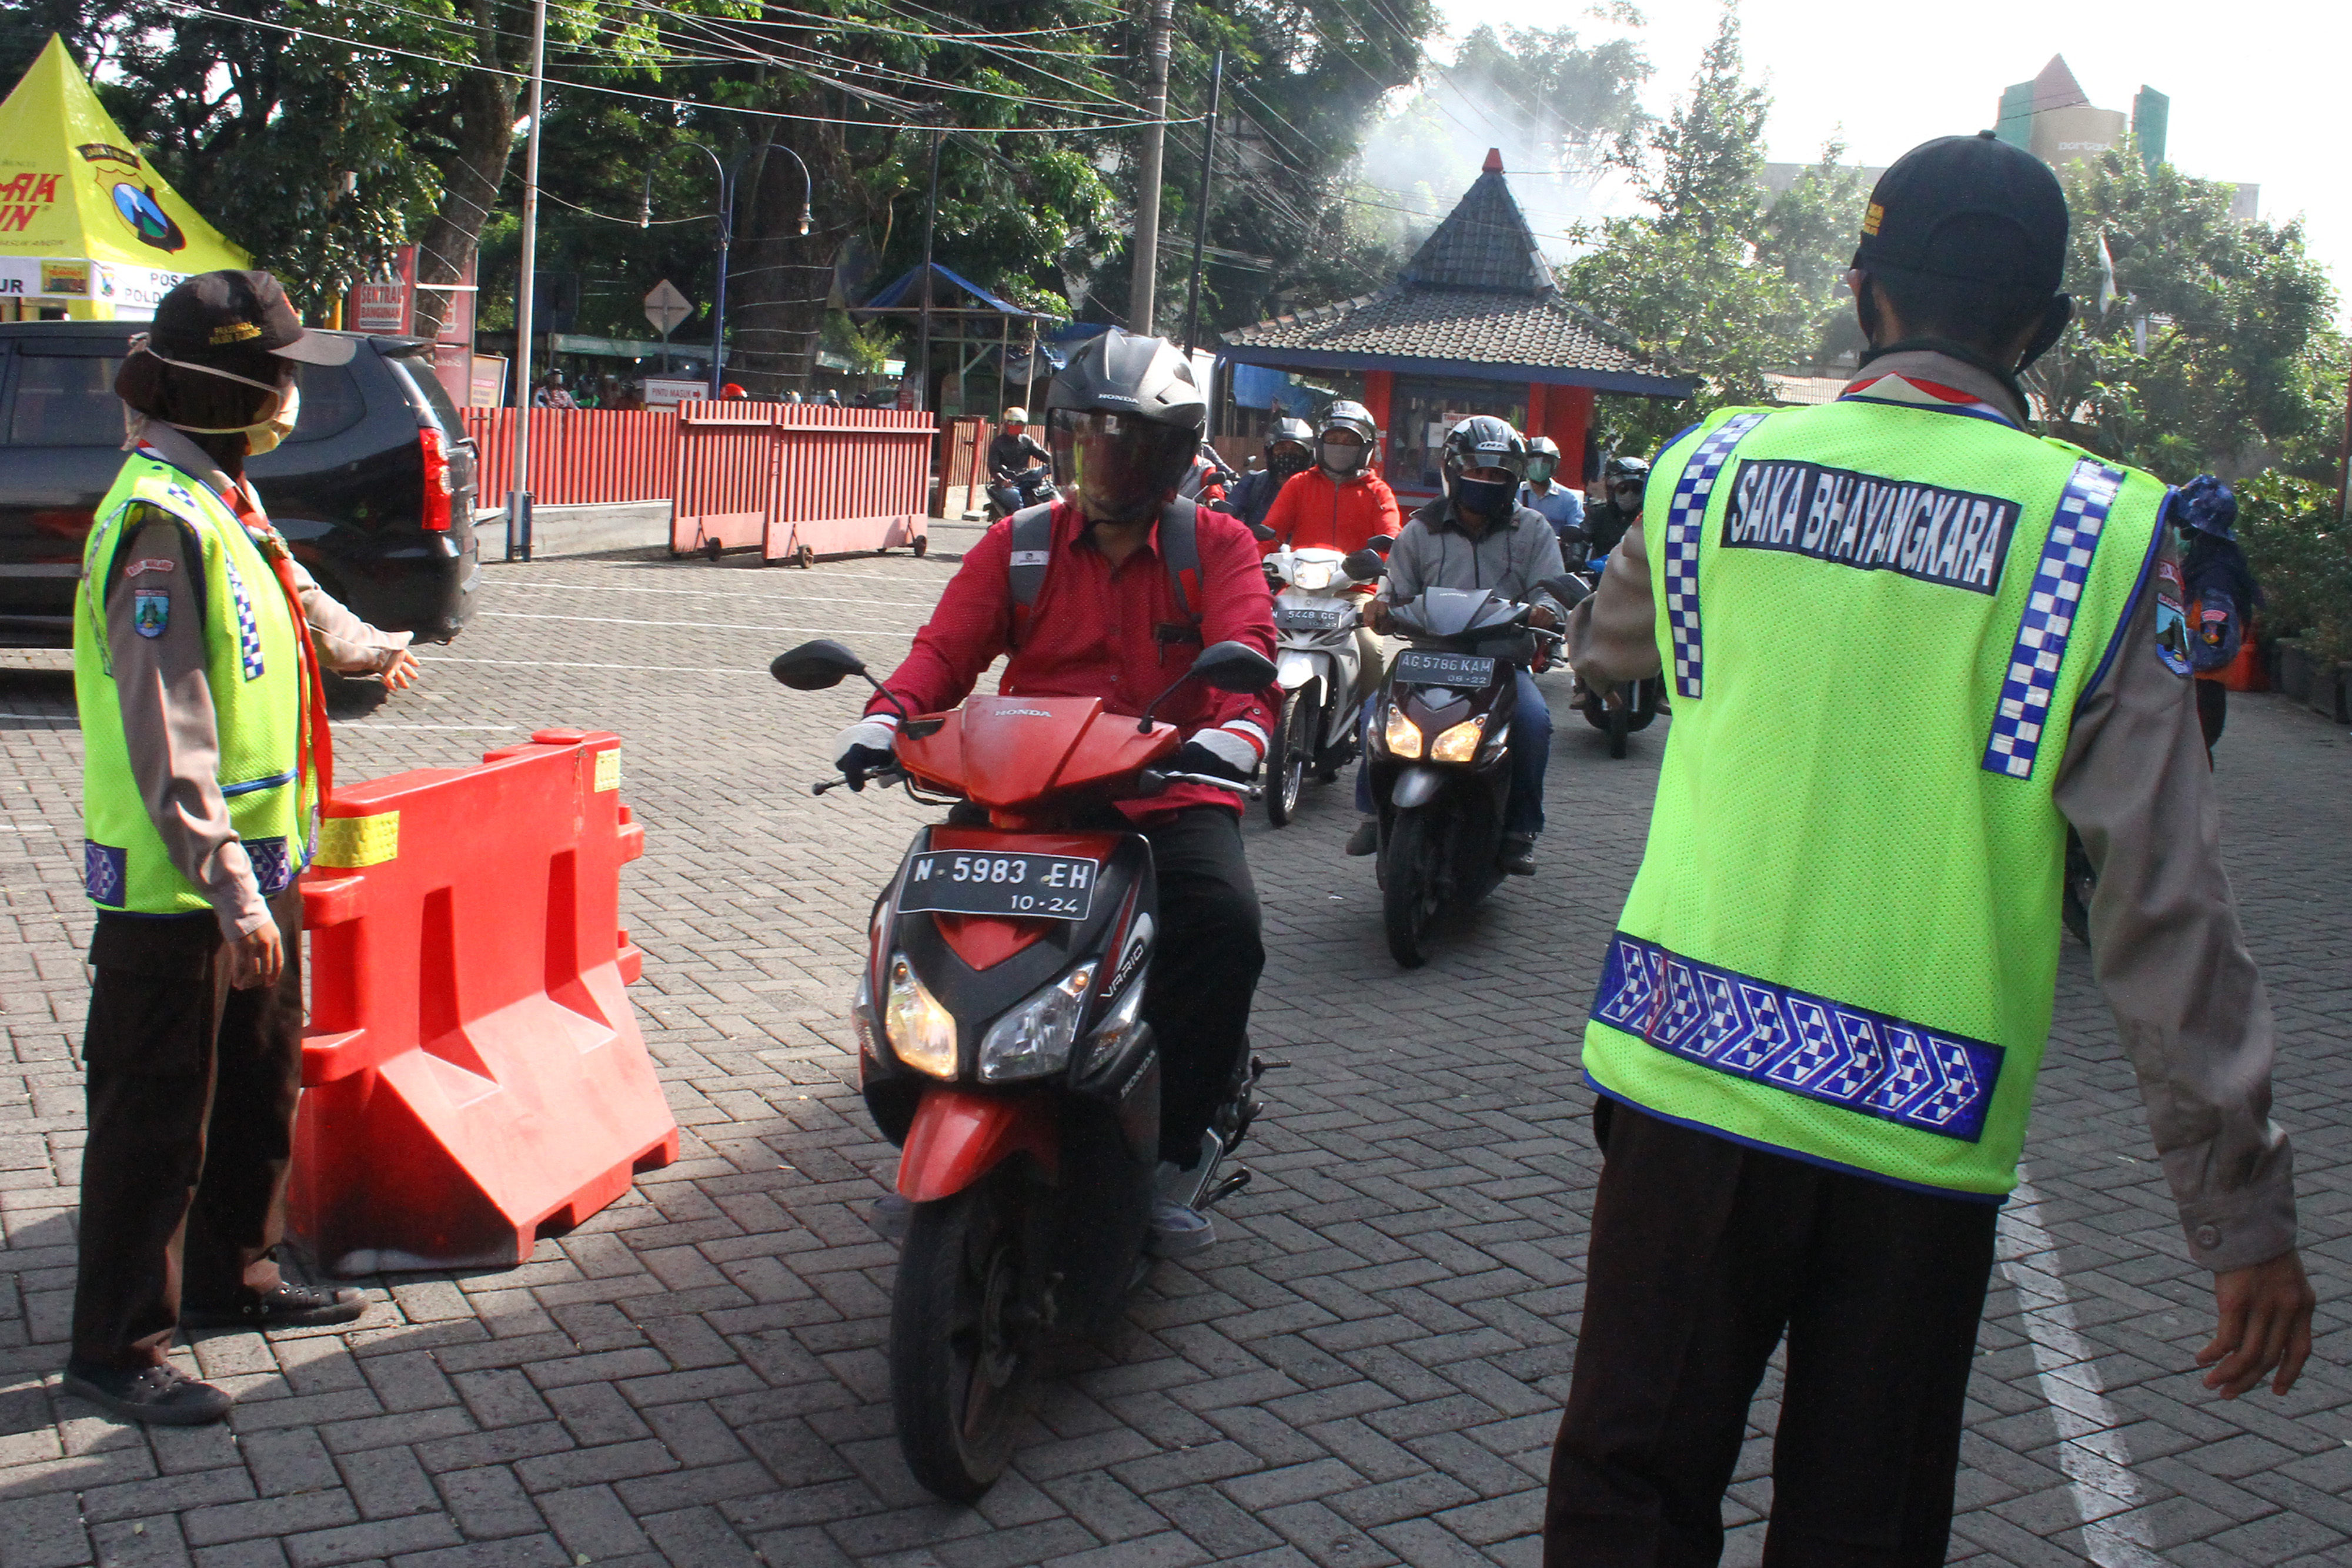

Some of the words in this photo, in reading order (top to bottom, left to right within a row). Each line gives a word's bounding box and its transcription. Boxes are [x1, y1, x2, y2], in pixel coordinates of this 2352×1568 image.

[362, 286, 402, 303] SENTRAL
[652, 388, 669, 397] PINTU
[670, 389, 691, 399] MASUK
[1098, 393, 1140, 404] HONDA
[1730, 464, 1807, 546] SAKA
[1800, 472, 2006, 587] BHAYANGKARA
[1402, 655, 1419, 667] AG
[1423, 657, 1458, 670] 5786
[995, 709, 1053, 717] HONDA
[914, 858, 934, 882] N
[953, 857, 1027, 884] 5983
[1049, 863, 1090, 889] EH
[1100, 944, 1144, 998] VARIO
[1121, 1049, 1156, 1099] HONDA
